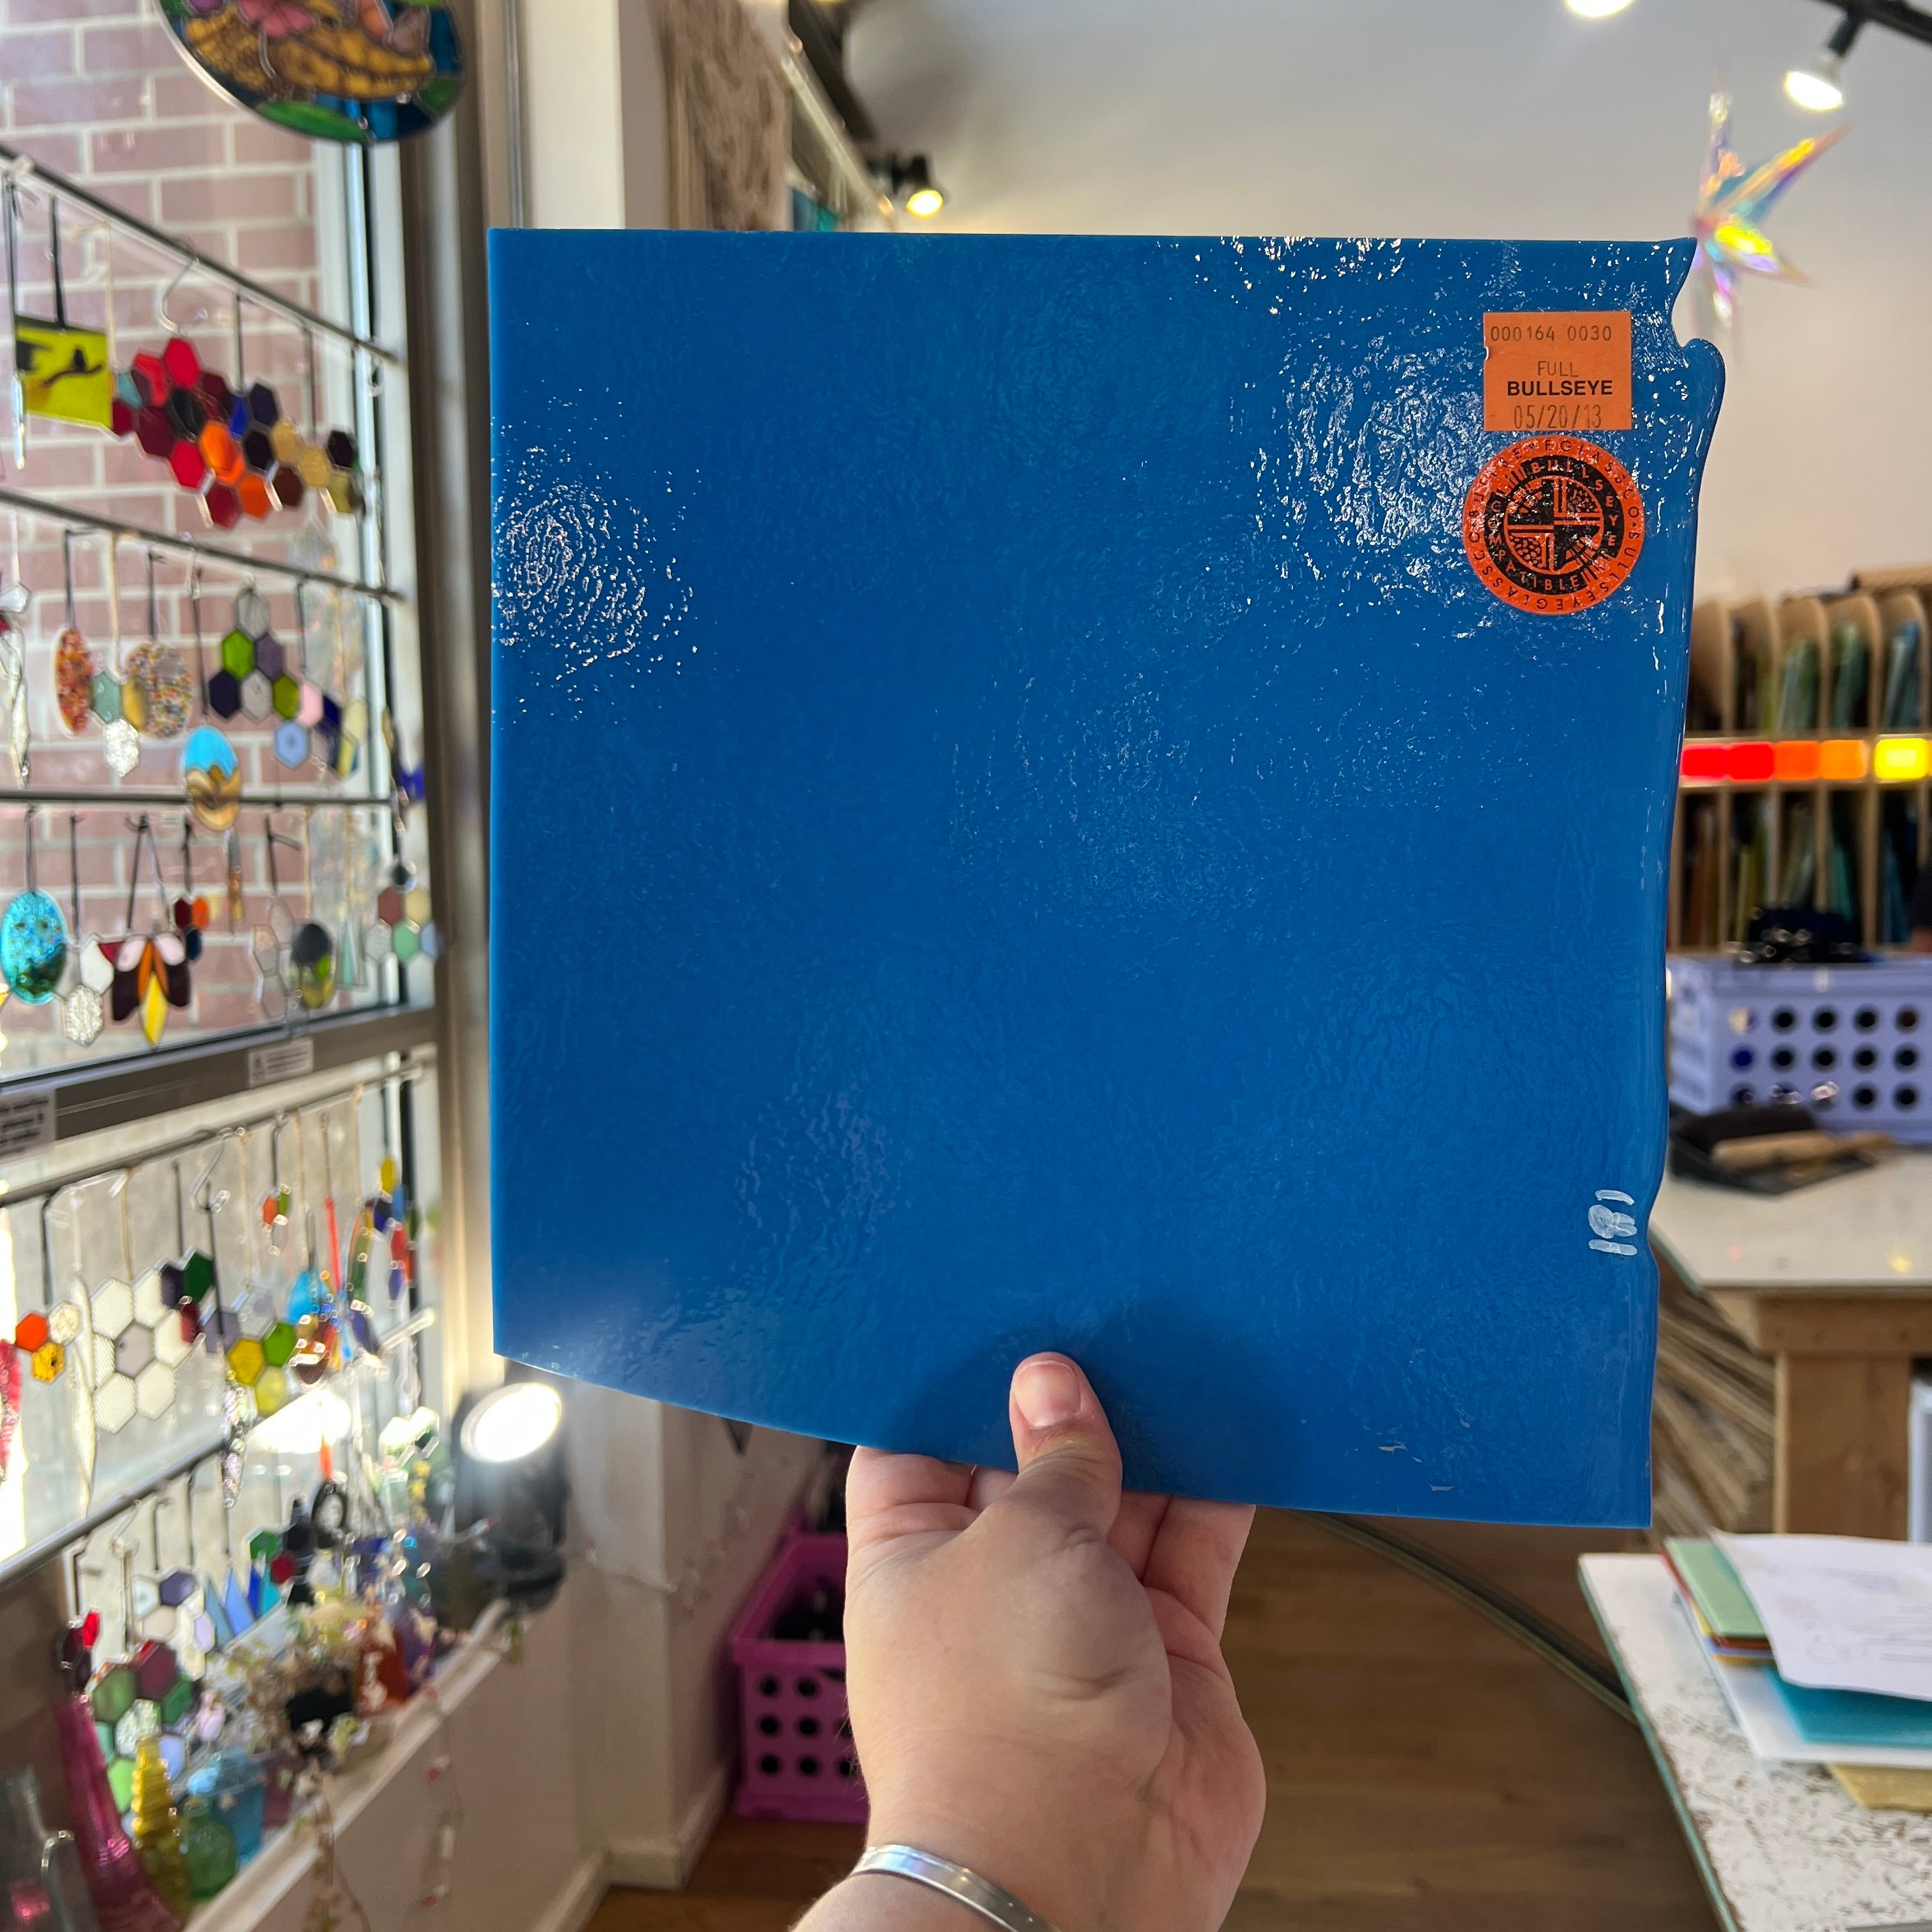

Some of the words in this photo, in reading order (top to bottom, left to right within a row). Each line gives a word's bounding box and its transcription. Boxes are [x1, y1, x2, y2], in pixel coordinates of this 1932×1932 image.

[1567, 325, 1612, 341] 0030
[1538, 360, 1579, 377] FULL
[1507, 380, 1613, 396] BULLSEYE
[1514, 404, 1602, 429] 05/20/13
[1531, 459, 1618, 548] BULLSEYE
[1487, 501, 1579, 590] COMPATIBLE
[1482, 566, 1547, 610] GLASS
[1557, 532, 1639, 611] BULLSEYE
